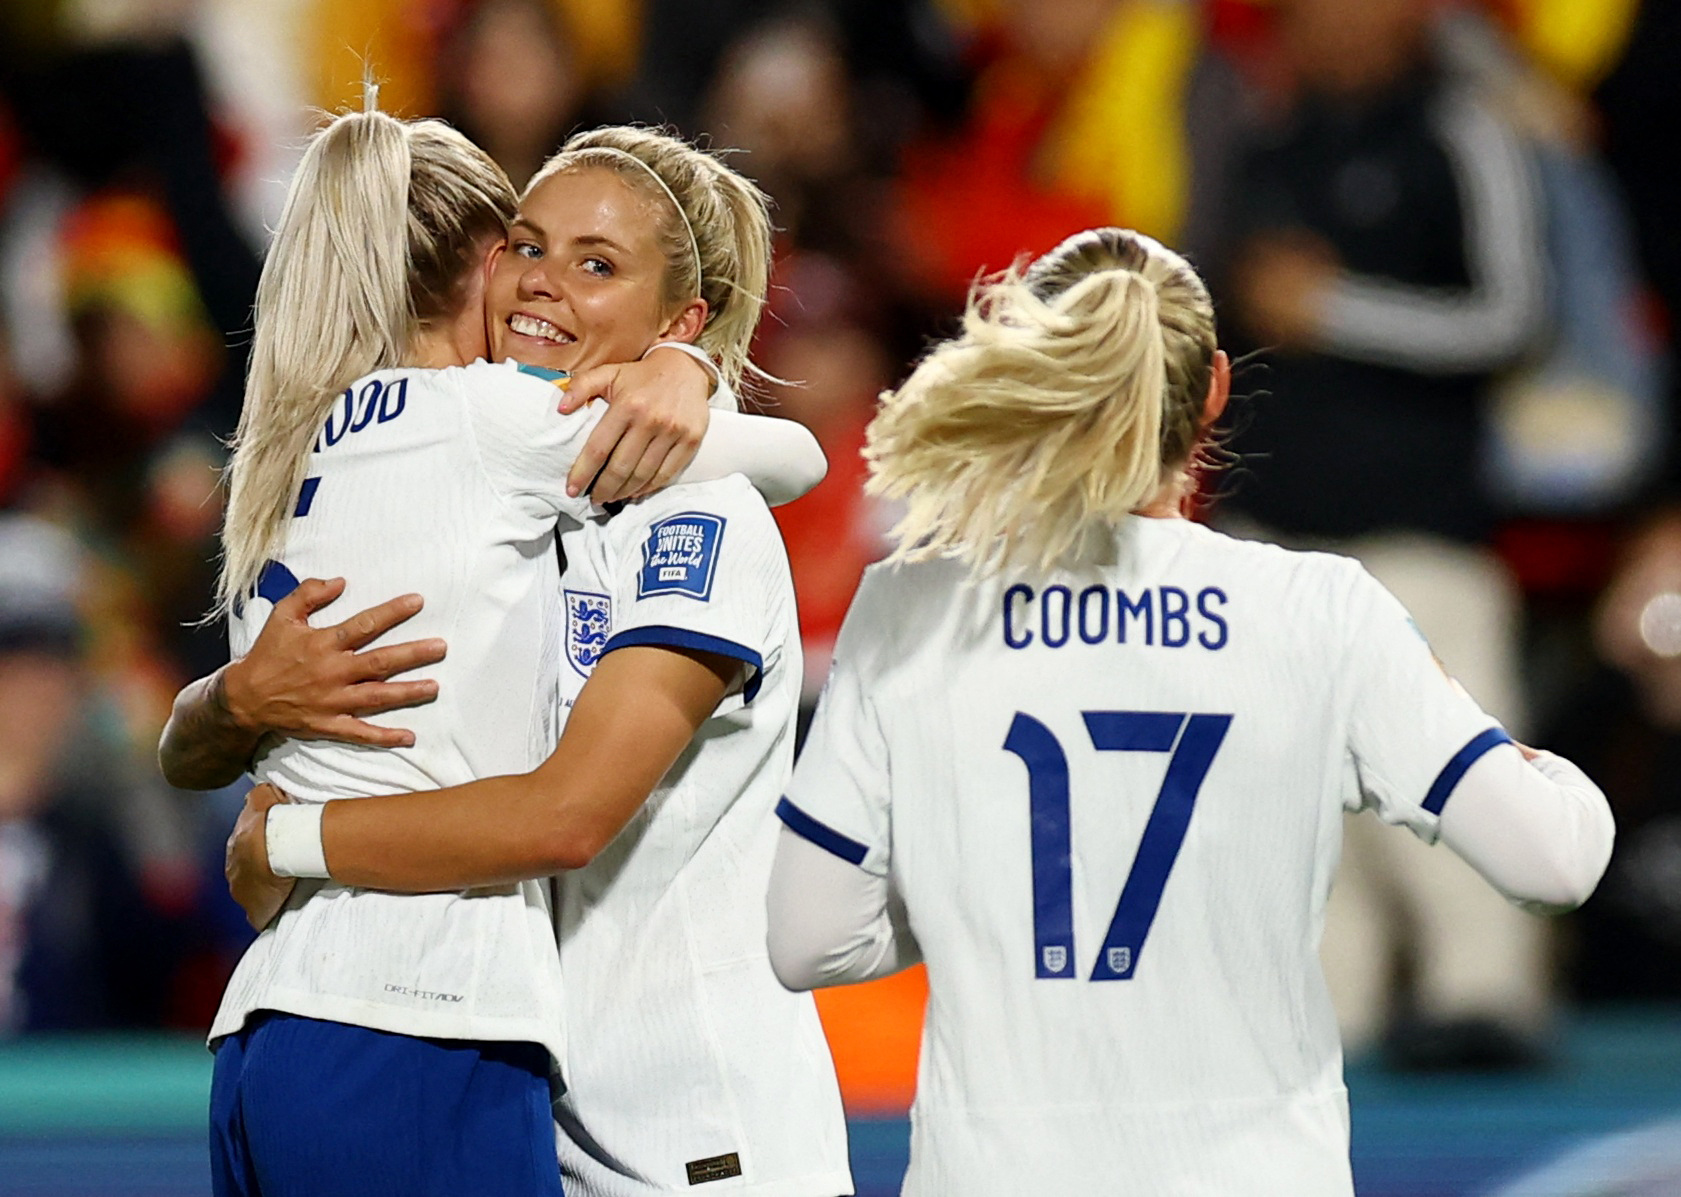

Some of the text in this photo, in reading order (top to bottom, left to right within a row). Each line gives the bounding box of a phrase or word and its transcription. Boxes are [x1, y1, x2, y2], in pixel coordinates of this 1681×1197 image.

[313, 377, 409, 454] OOD
[656, 535, 704, 553] UNITES
[657, 524, 704, 538] FOOTBALL
[650, 551, 704, 569] the World
[1003, 583, 1229, 651] COOMBS
[1002, 710, 1235, 981] 17
